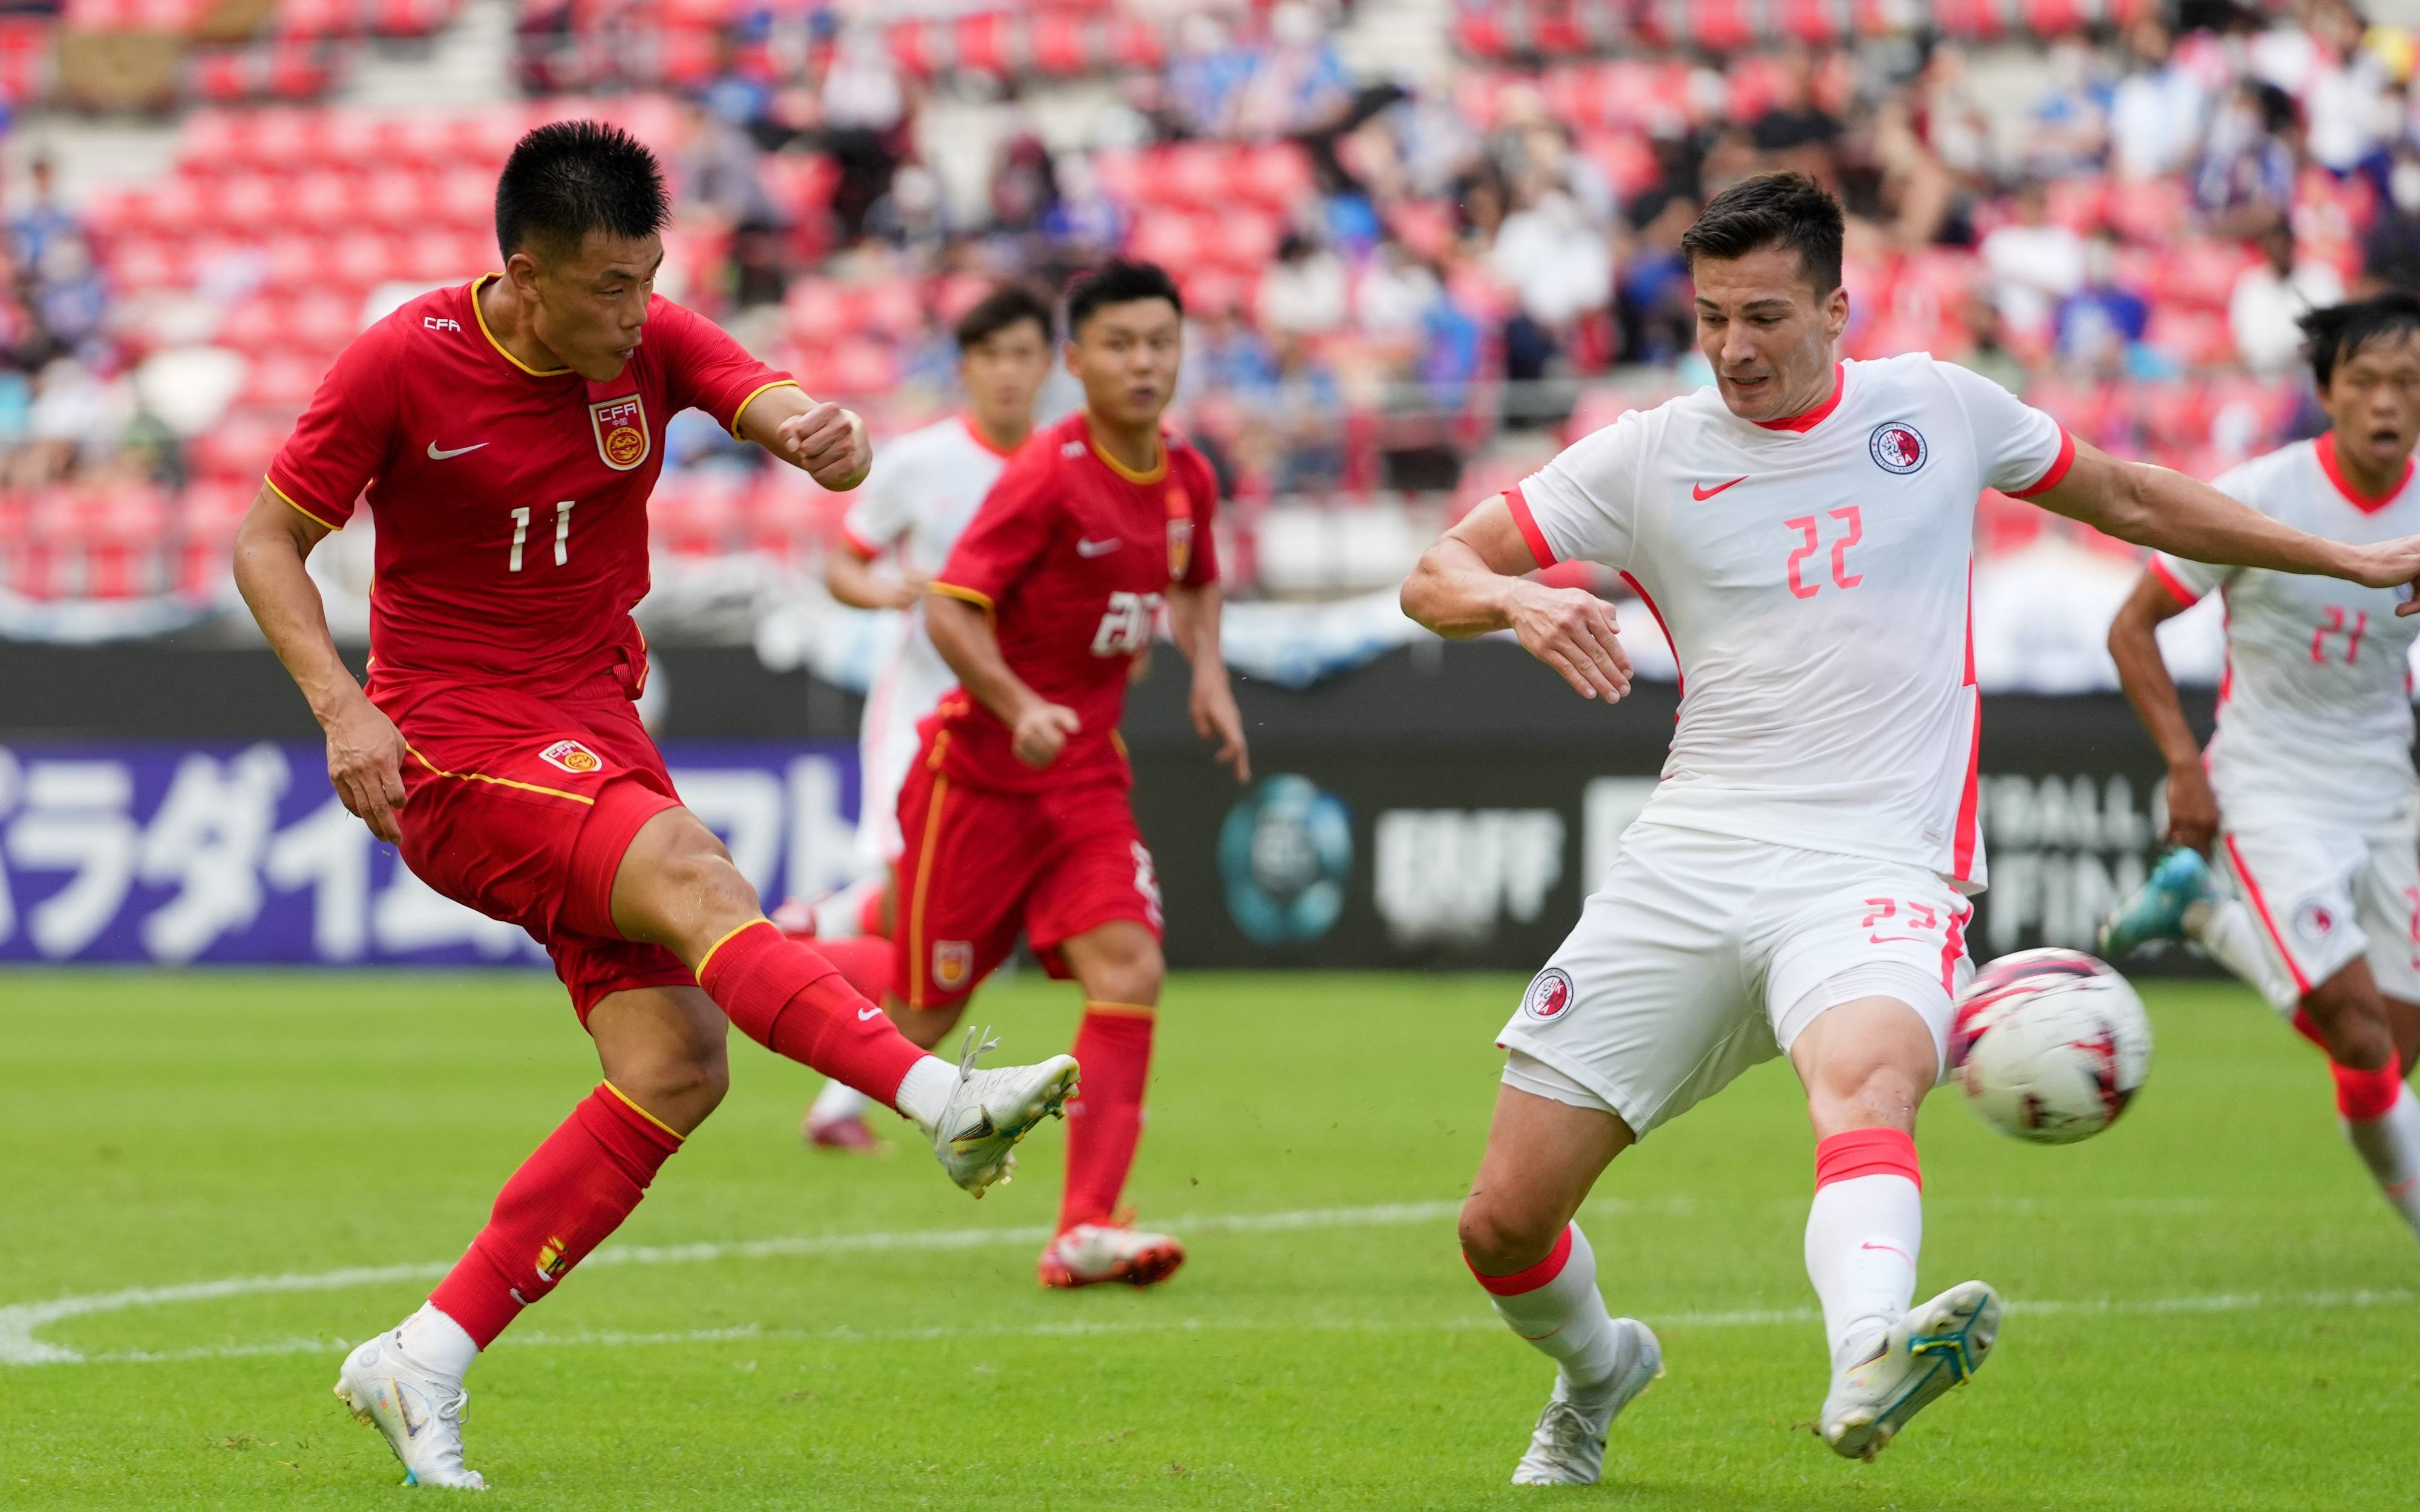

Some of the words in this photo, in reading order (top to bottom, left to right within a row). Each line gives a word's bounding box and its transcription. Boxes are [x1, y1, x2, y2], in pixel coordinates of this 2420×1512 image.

[424, 316, 460, 332] CFA
[598, 402, 637, 422] CFA
[509, 501, 575, 572] 11
[1782, 504, 1864, 599] 22
[2310, 605, 2367, 665] 21
